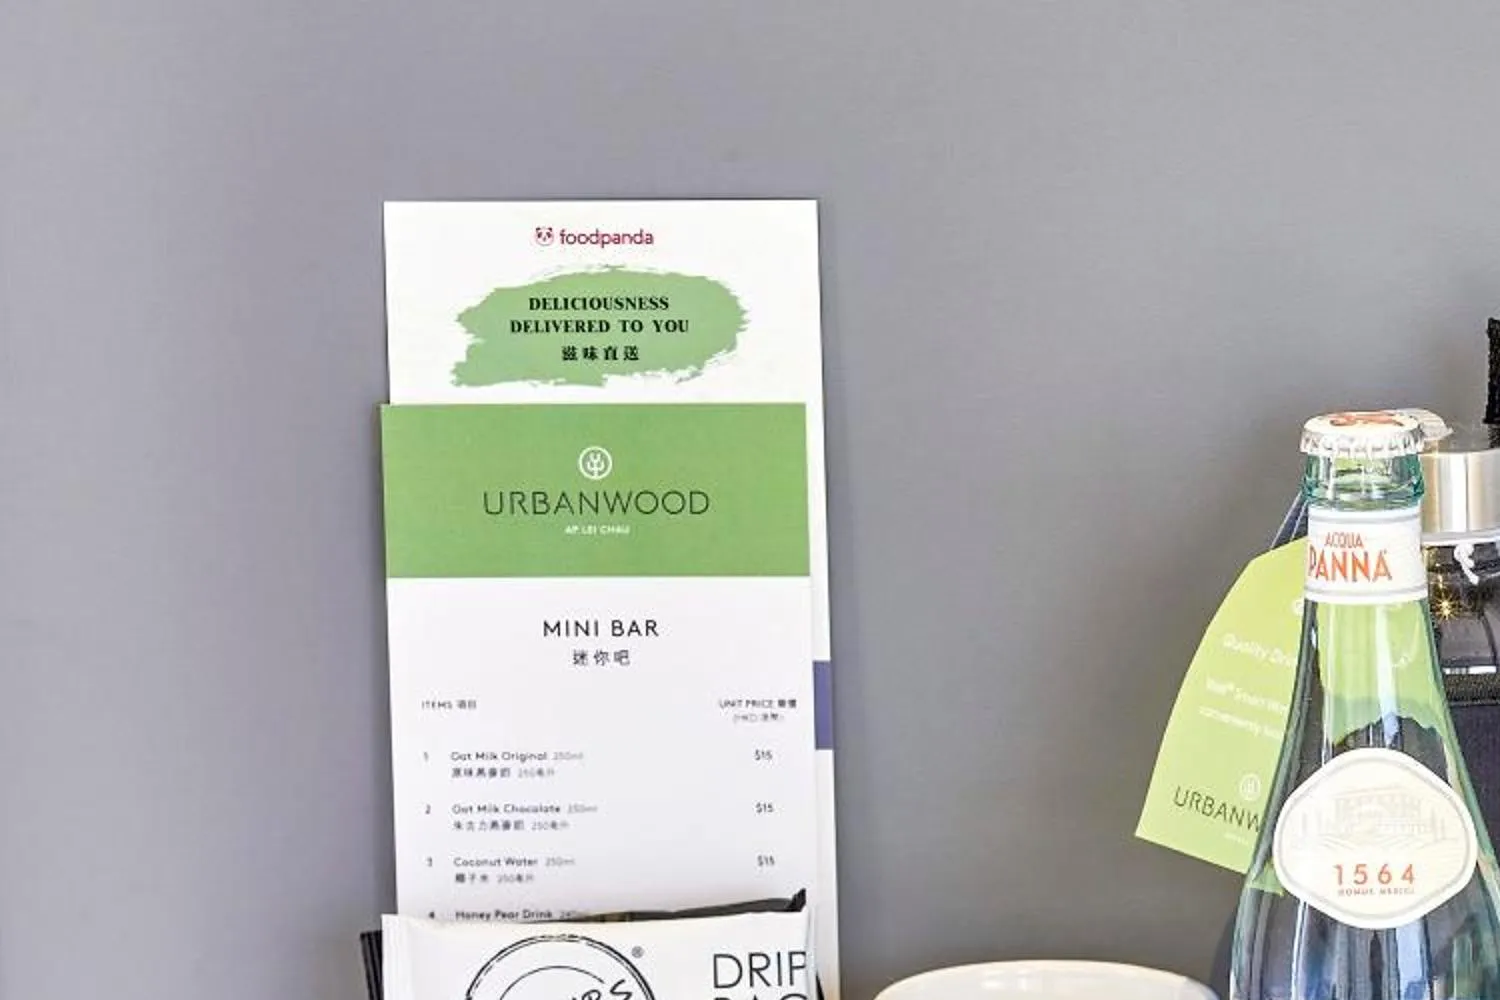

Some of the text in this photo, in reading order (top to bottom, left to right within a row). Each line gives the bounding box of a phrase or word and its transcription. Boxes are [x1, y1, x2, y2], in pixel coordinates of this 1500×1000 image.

[560, 228, 654, 248] foodpanda
[528, 297, 669, 311] DELICIOUSNESS
[510, 319, 689, 334] DELIVERED TO YOU
[483, 491, 710, 516] URBANWOOD
[1324, 531, 1364, 549] ACQUA
[1308, 544, 1393, 583] PANNA
[543, 619, 660, 637] MINI BAR
[572, 649, 630, 666] 迷你吧
[421, 700, 453, 710] ITEMS
[745, 699, 773, 708] PRICE
[450, 751, 472, 761] Oat
[475, 751, 498, 761] Milk
[501, 751, 547, 764] Original
[755, 749, 773, 761] $15
[425, 805, 431, 814] 2
[451, 803, 473, 814] Oat
[477, 803, 500, 814] Milk
[503, 803, 561, 814] Chocolate
[756, 803, 774, 814] $15
[453, 857, 501, 867] Coconut
[504, 857, 539, 867] Water
[757, 856, 775, 867] $15
[1332, 863, 1415, 886] 1564
[455, 910, 491, 921] Honey
[494, 909, 519, 920] Pear
[521, 909, 553, 920] Drink
